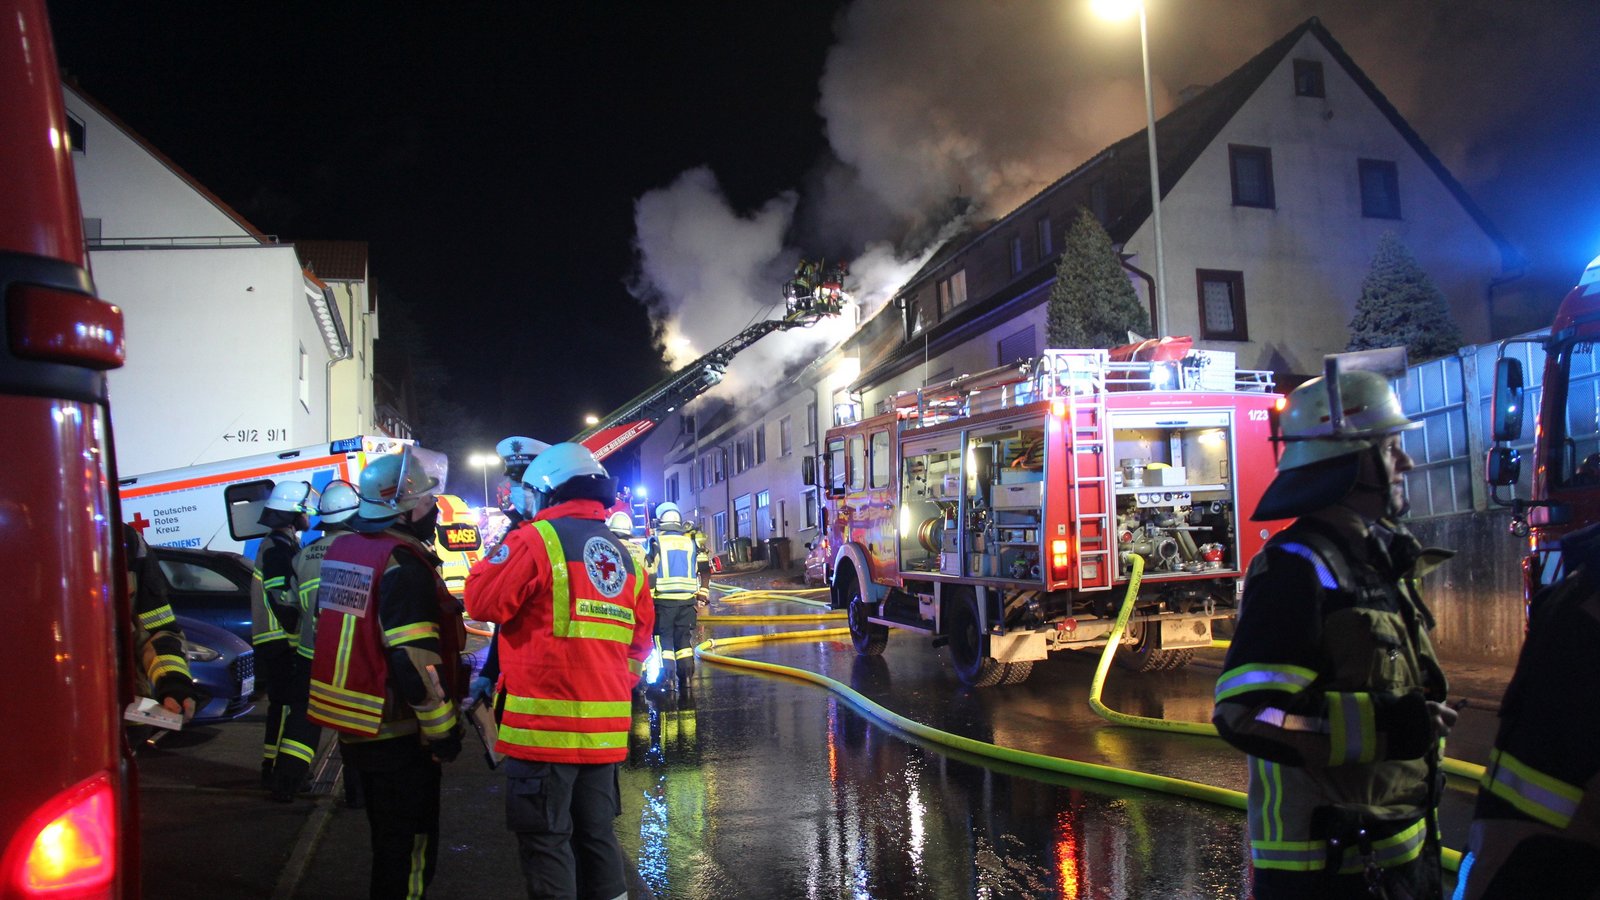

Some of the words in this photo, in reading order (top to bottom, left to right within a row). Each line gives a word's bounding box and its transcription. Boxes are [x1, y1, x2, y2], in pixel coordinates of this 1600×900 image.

[1248, 409, 1269, 421] 1/23
[237, 429, 258, 442] 9/2
[267, 428, 286, 441] 9/1
[153, 505, 197, 517] Deutsches
[155, 516, 179, 526] Rotes
[156, 525, 180, 535] Kreuz
[457, 528, 476, 543] ASB
